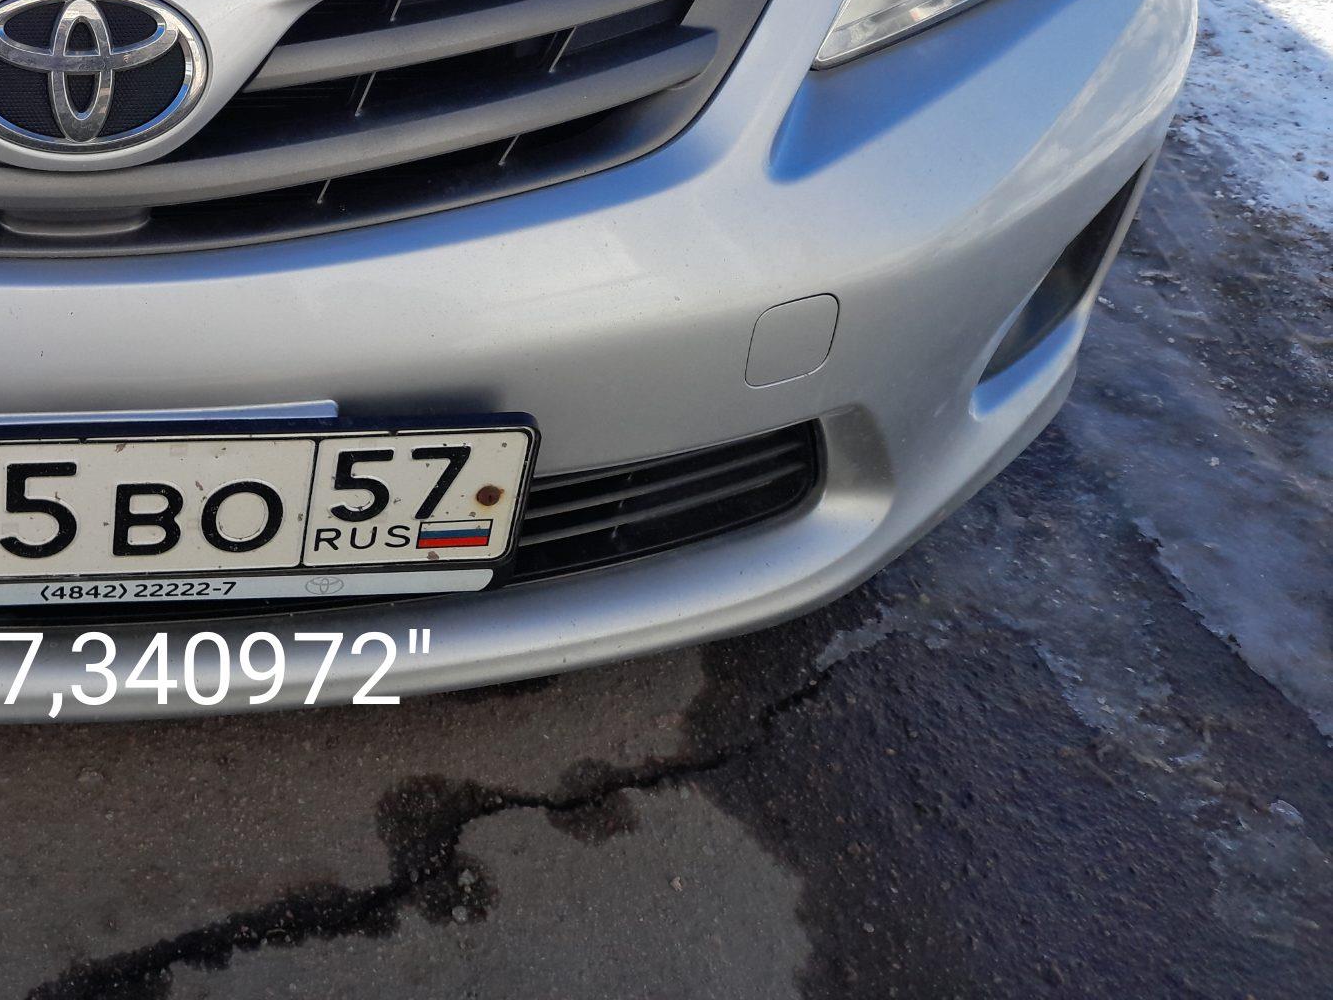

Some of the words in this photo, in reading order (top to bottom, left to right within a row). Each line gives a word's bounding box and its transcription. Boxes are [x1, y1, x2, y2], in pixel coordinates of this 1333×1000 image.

[330, 446, 471, 522] 57
[314, 525, 411, 551] RUS
[134, 581, 236, 597] 22222-7
